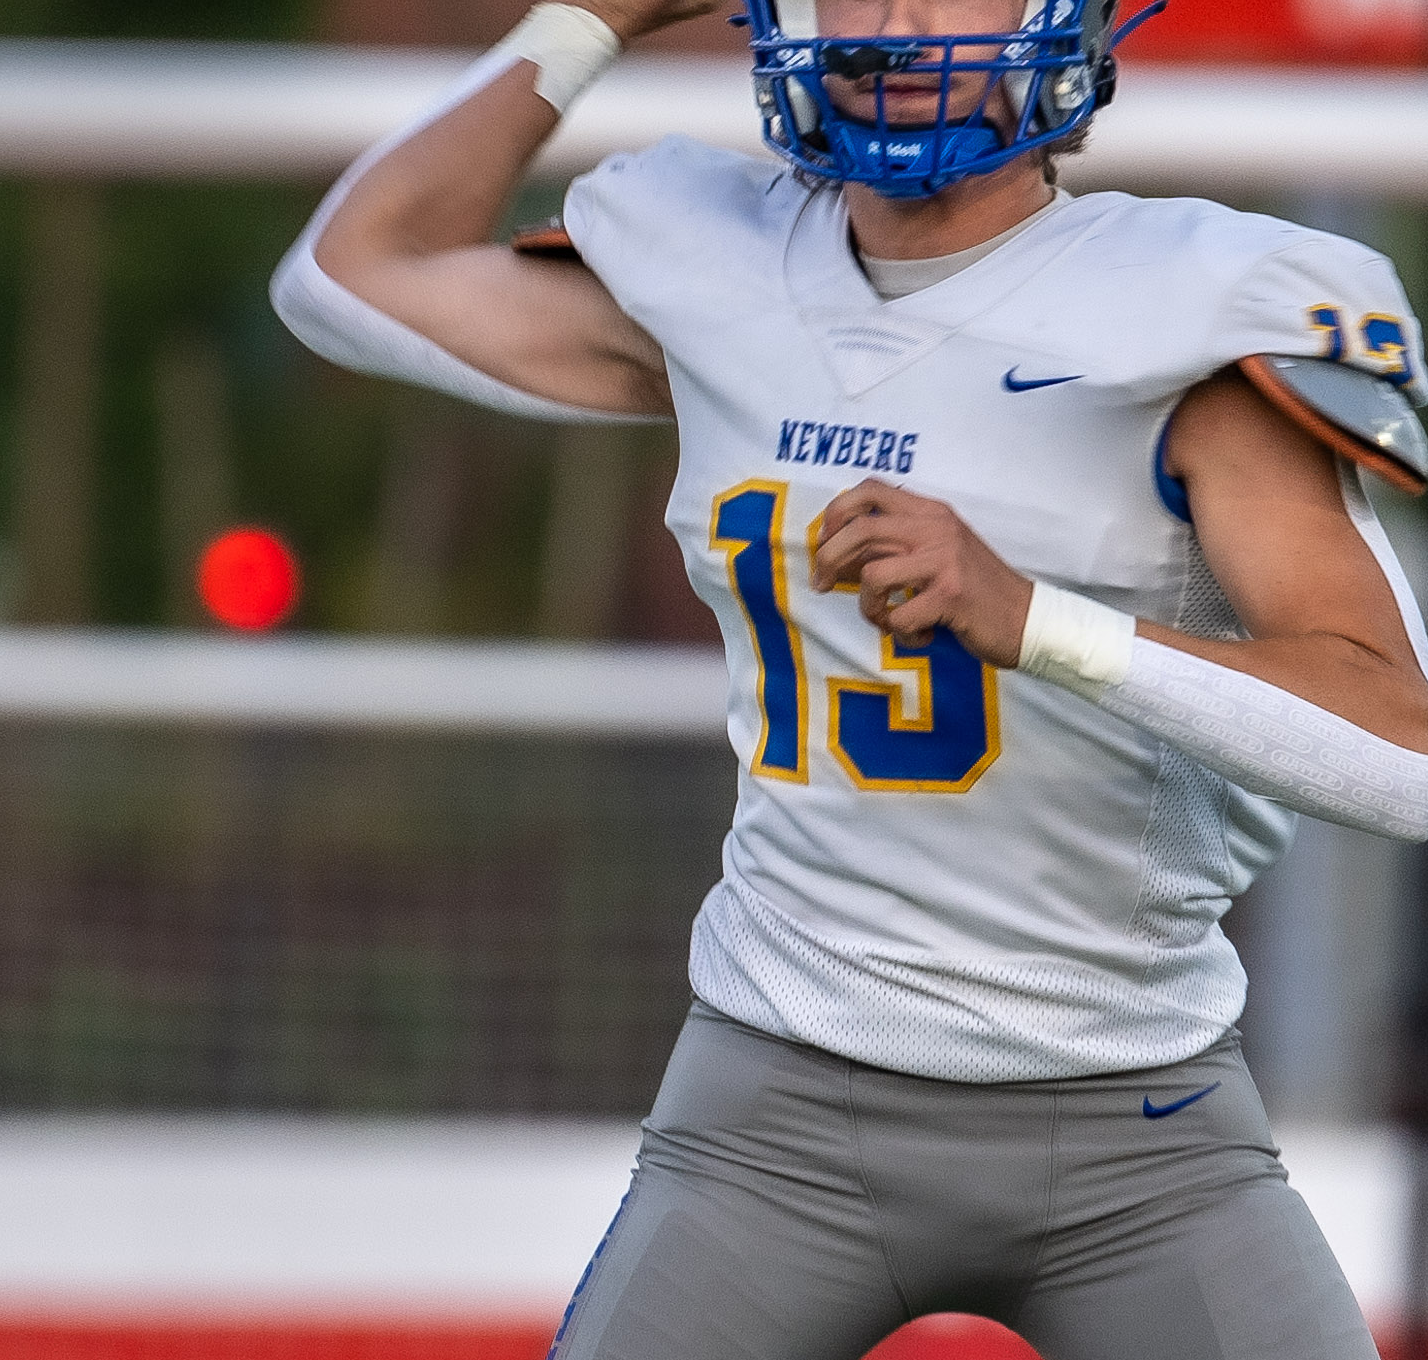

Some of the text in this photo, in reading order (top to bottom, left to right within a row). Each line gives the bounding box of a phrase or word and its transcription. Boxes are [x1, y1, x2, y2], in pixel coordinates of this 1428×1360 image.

[774, 417, 919, 474] NEWBERG
[709, 478, 1001, 794] 13
[1277, 752, 1340, 787] BATTLE
